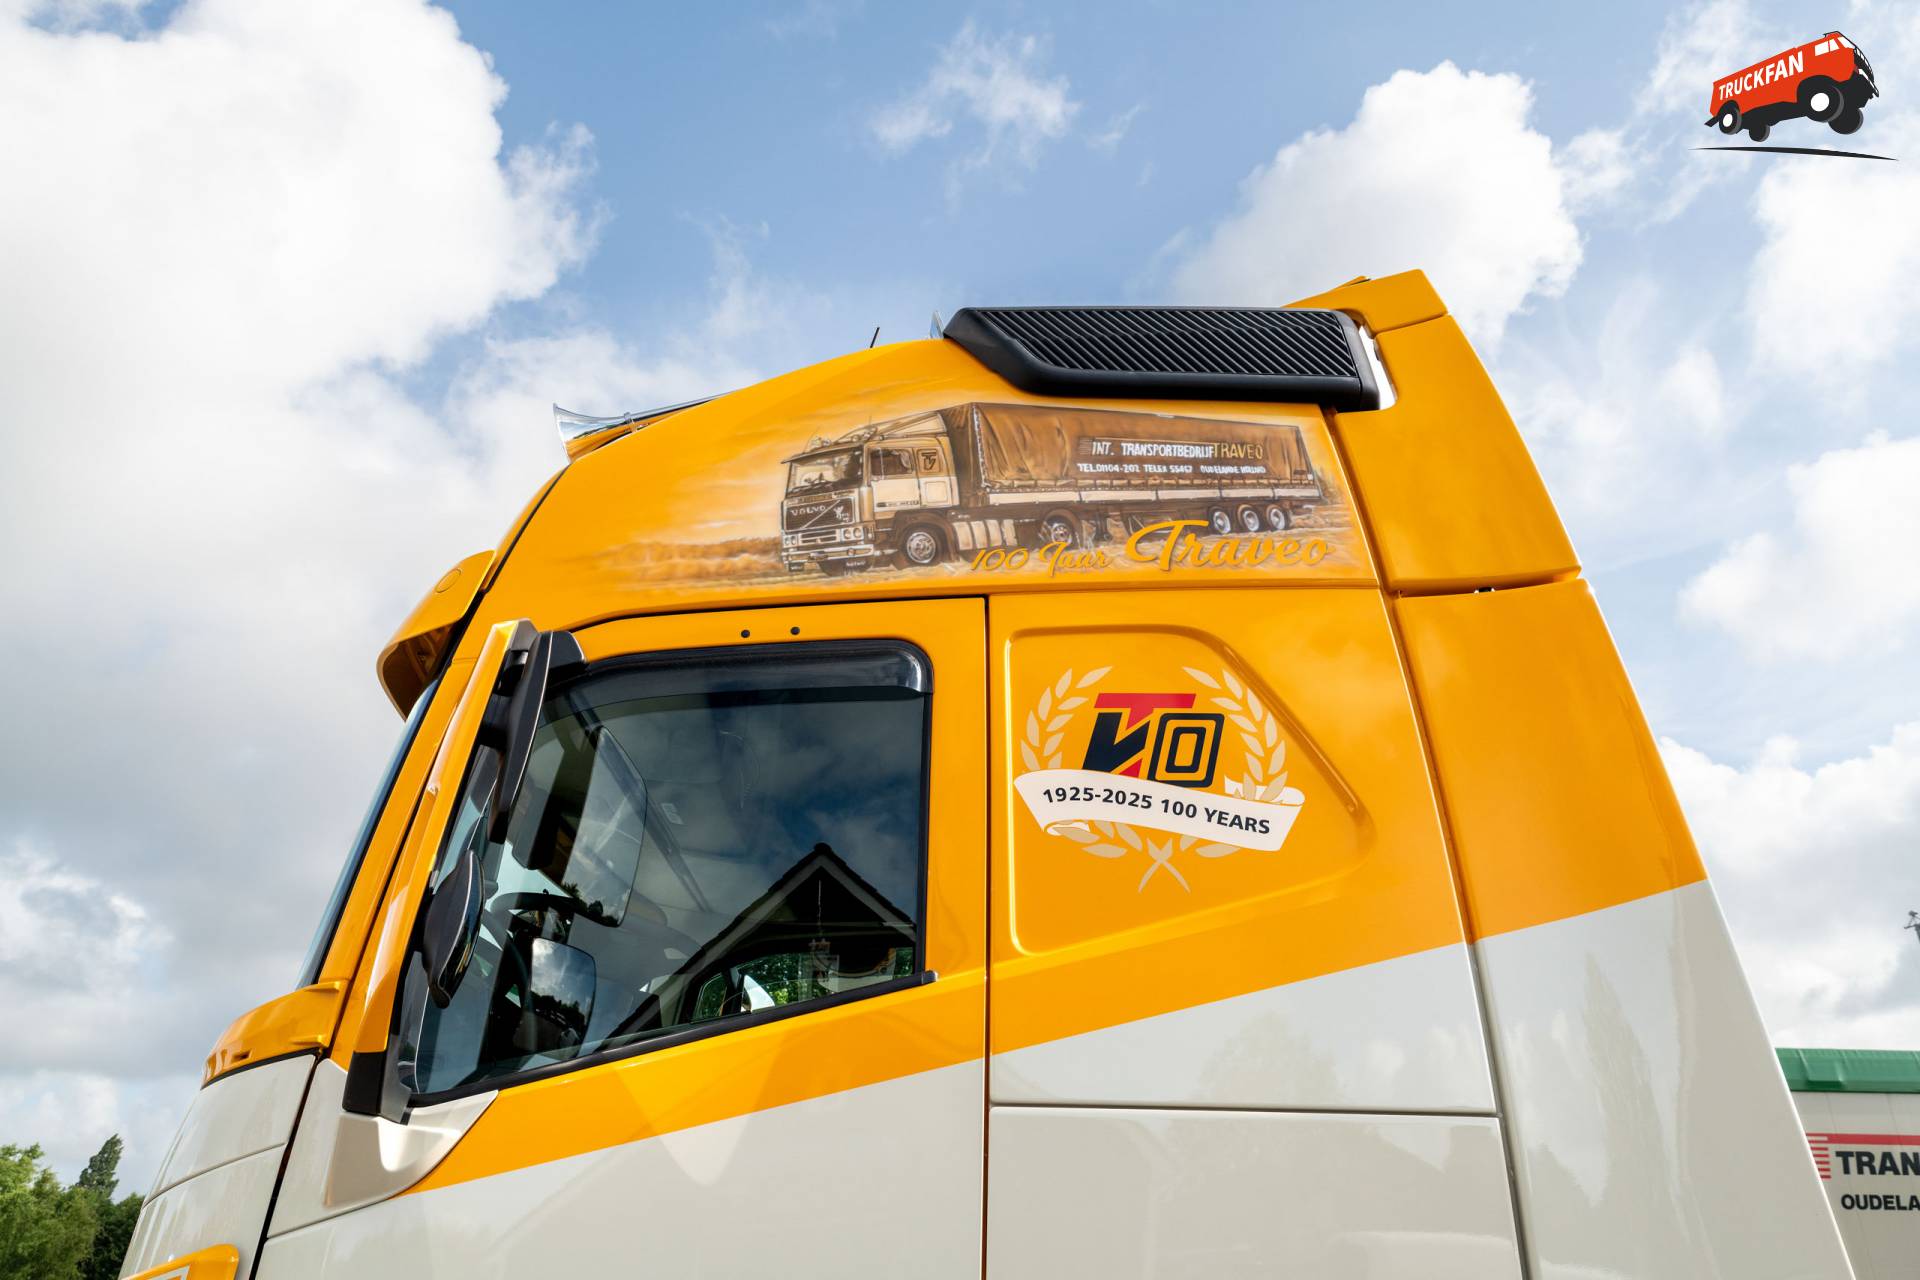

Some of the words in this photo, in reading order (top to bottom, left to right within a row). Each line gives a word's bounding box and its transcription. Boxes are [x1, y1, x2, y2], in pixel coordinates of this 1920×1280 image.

[1091, 441, 1115, 456] INT.
[791, 505, 826, 516] VOLVO
[971, 548, 1029, 571] 100
[1038, 541, 1112, 577] Jaar
[1125, 519, 1333, 572] Traveo
[1042, 787, 1153, 809] 1925-2025
[1161, 799, 1197, 818] 100
[1204, 807, 1271, 834] YEARS
[1835, 1151, 1920, 1176] TRAN
